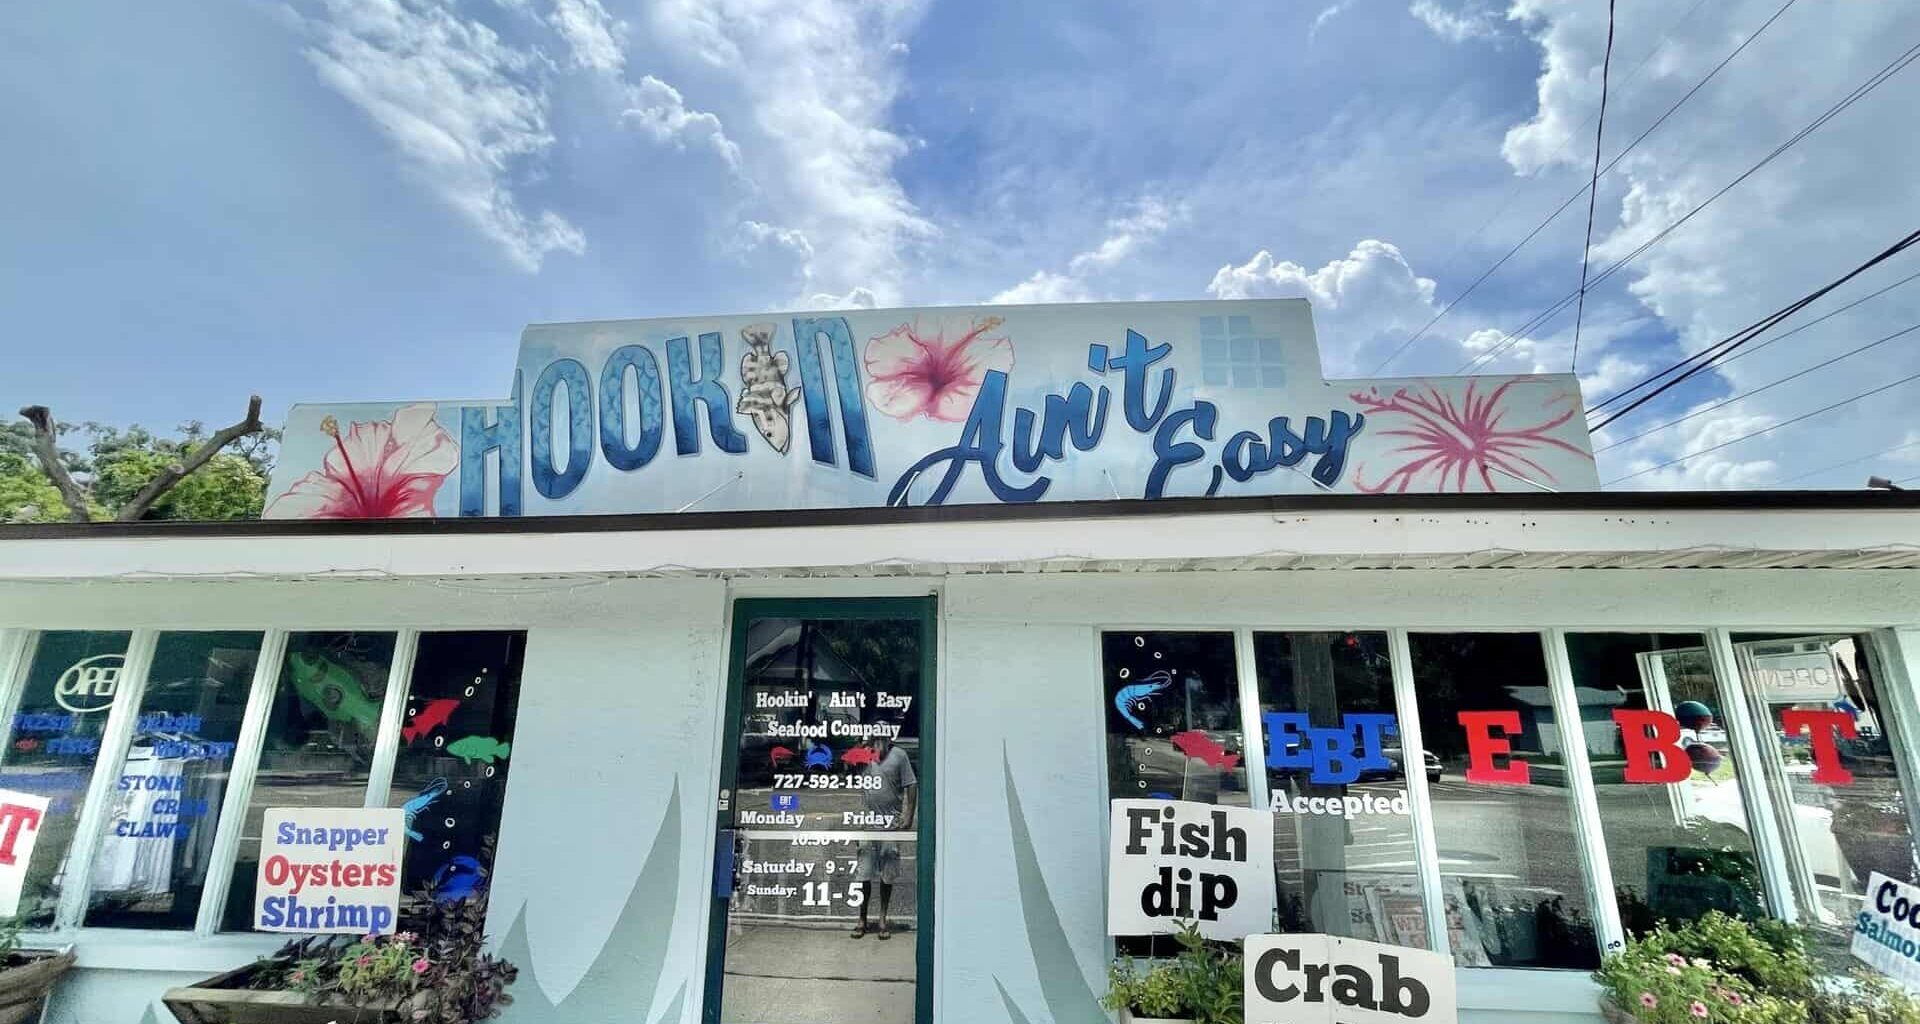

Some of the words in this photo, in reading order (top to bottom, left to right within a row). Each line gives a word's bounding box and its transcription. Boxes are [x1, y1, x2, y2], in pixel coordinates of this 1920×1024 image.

[1144, 402, 1365, 501] Easy
[756, 690, 813, 708] Hookin'
[829, 691, 866, 708] Ain't
[876, 692, 912, 712] Easy
[767, 720, 827, 738] Seafood
[831, 720, 901, 740] Company
[1264, 711, 1397, 784] EBT
[773, 773, 882, 790] 727-592-1388
[740, 810, 805, 828] Monday
[842, 811, 895, 828] Friday
[1269, 788, 1410, 820] Accepted
[276, 821, 390, 852] Snapper
[1125, 805, 1248, 863] Fish
[264, 854, 398, 895] Oysters
[741, 859, 816, 876] Saturday
[747, 884, 798, 898] Sunday:
[1141, 866, 1239, 922] dip
[261, 895, 392, 934] Shrimp
[1855, 911, 1920, 962] Salmo
[1254, 947, 1431, 1018] Crab
